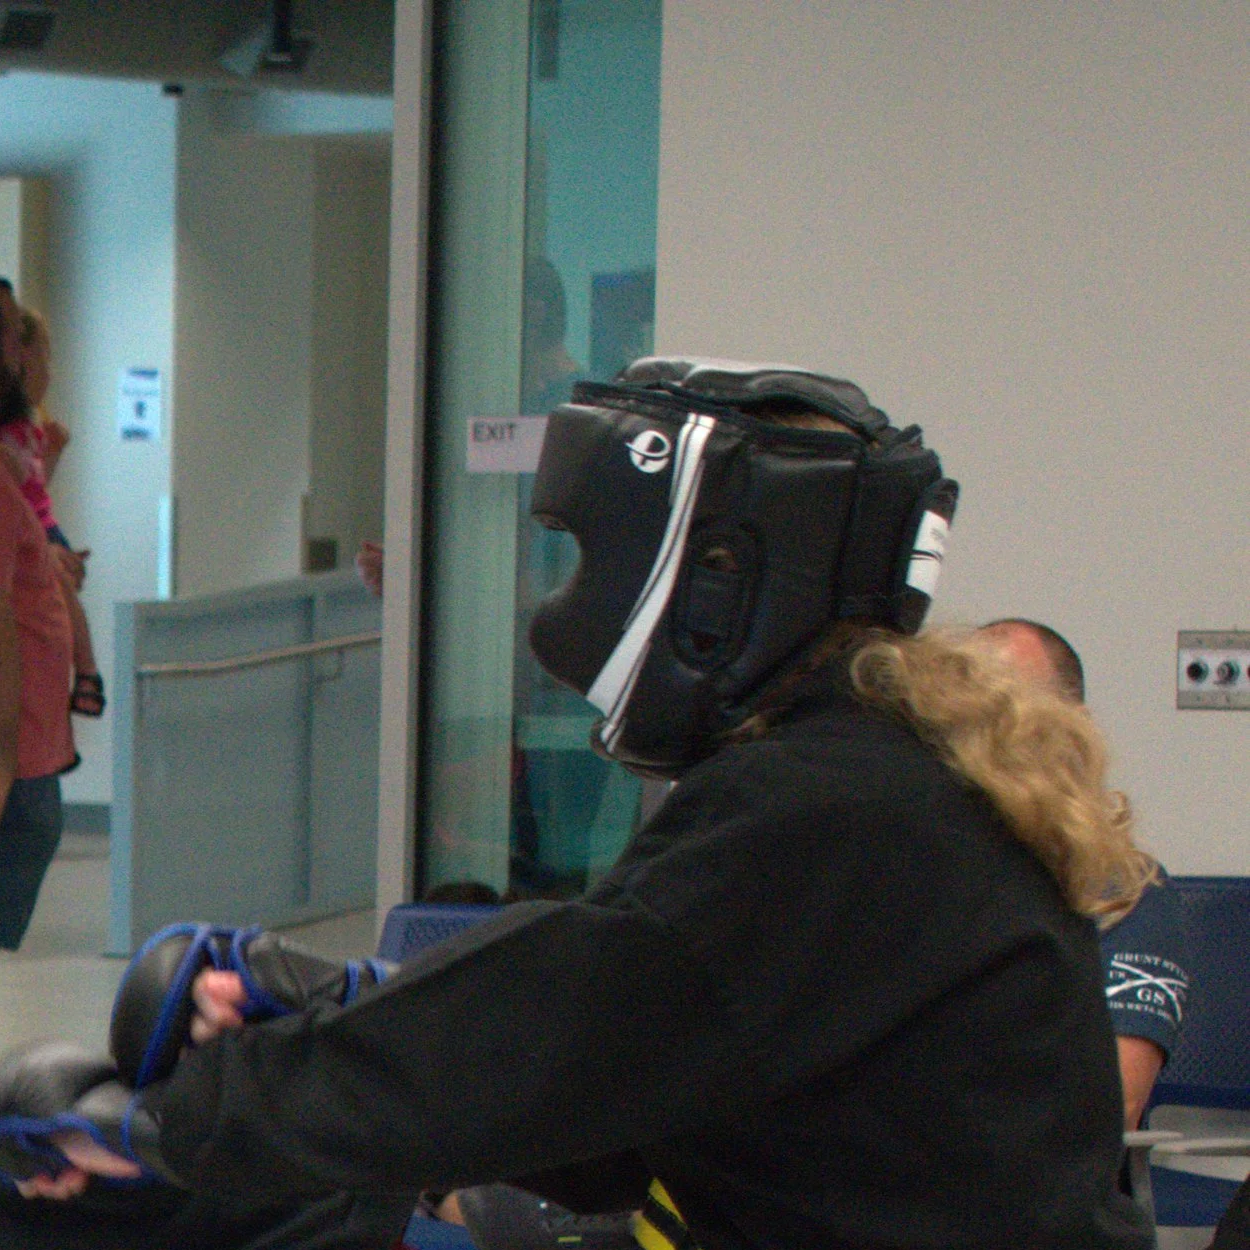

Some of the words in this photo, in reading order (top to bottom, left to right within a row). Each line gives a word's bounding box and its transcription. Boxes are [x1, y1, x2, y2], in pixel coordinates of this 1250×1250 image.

[473, 421, 516, 442] EXIT
[1114, 952, 1161, 966] GRUNT
[1137, 987, 1166, 1006] GS
